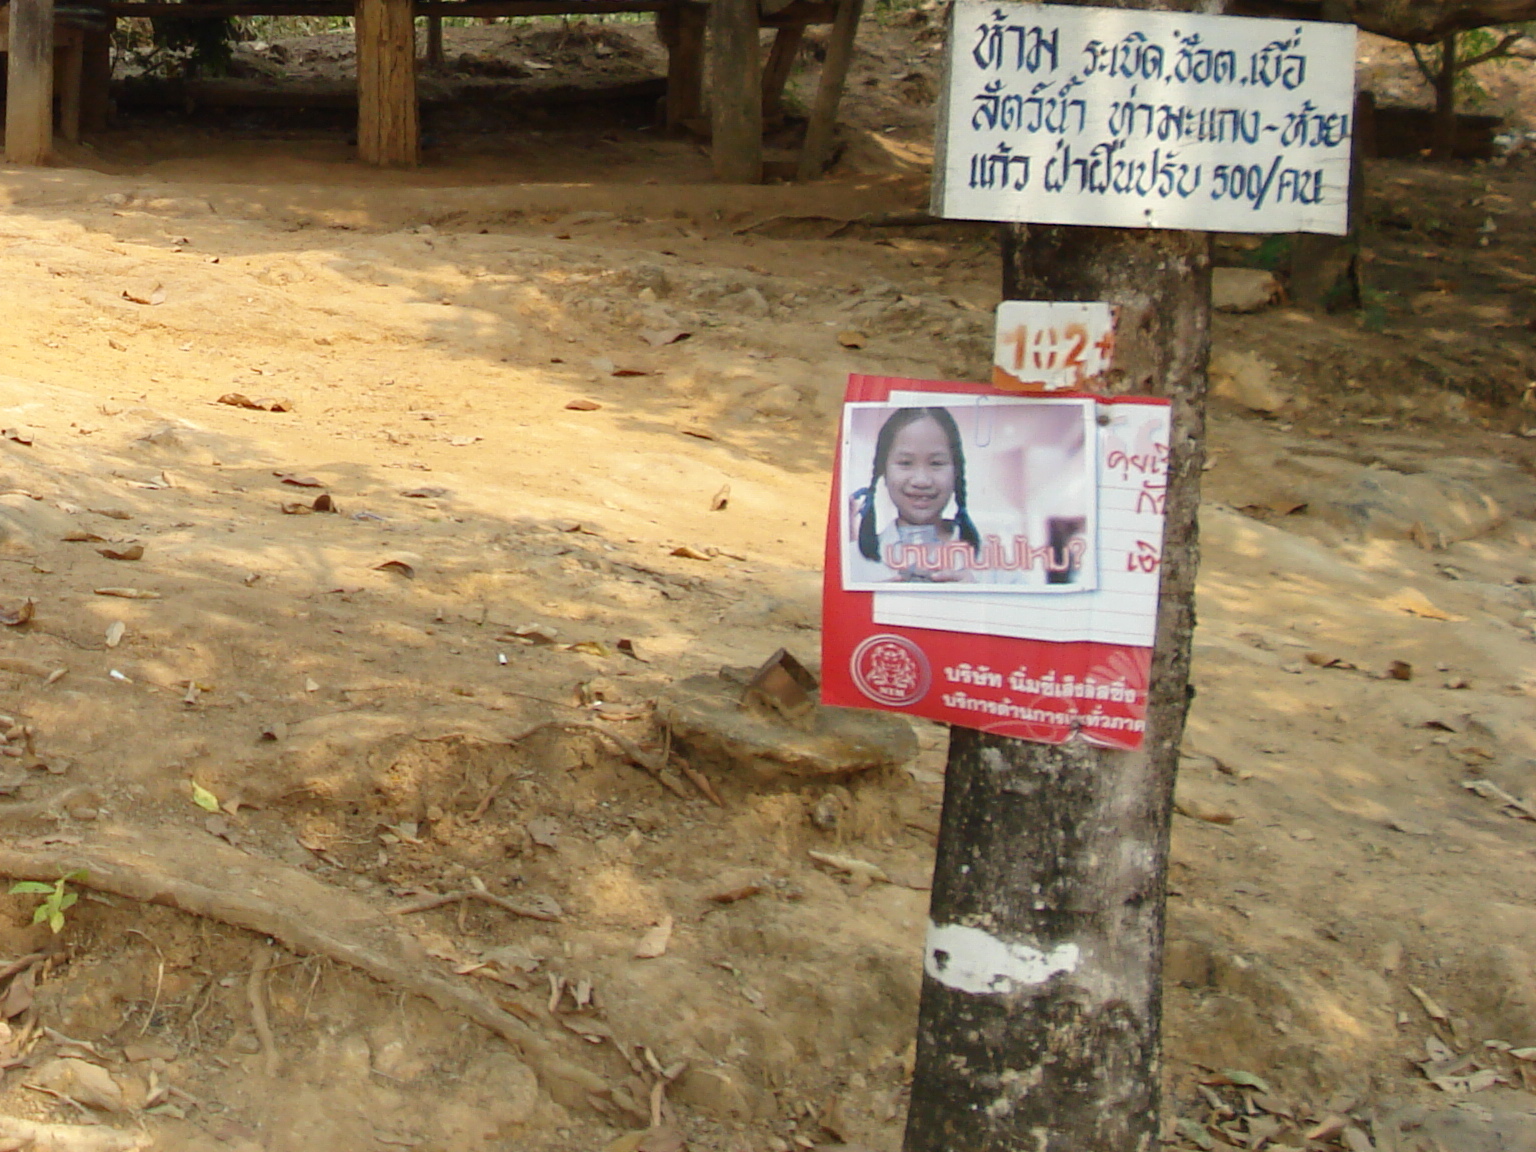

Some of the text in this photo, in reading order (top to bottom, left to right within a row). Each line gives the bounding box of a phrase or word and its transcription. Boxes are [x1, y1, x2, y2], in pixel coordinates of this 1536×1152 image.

[972, 8, 1060, 75] ห้าม
[971, 75, 1087, 136] สัตว์น้ำ
[968, 140, 1032, 192] แก้ว
[1043, 138, 1203, 198] ฝ่าฝืนปรับ
[943, 662, 1004, 689] บริษัท
